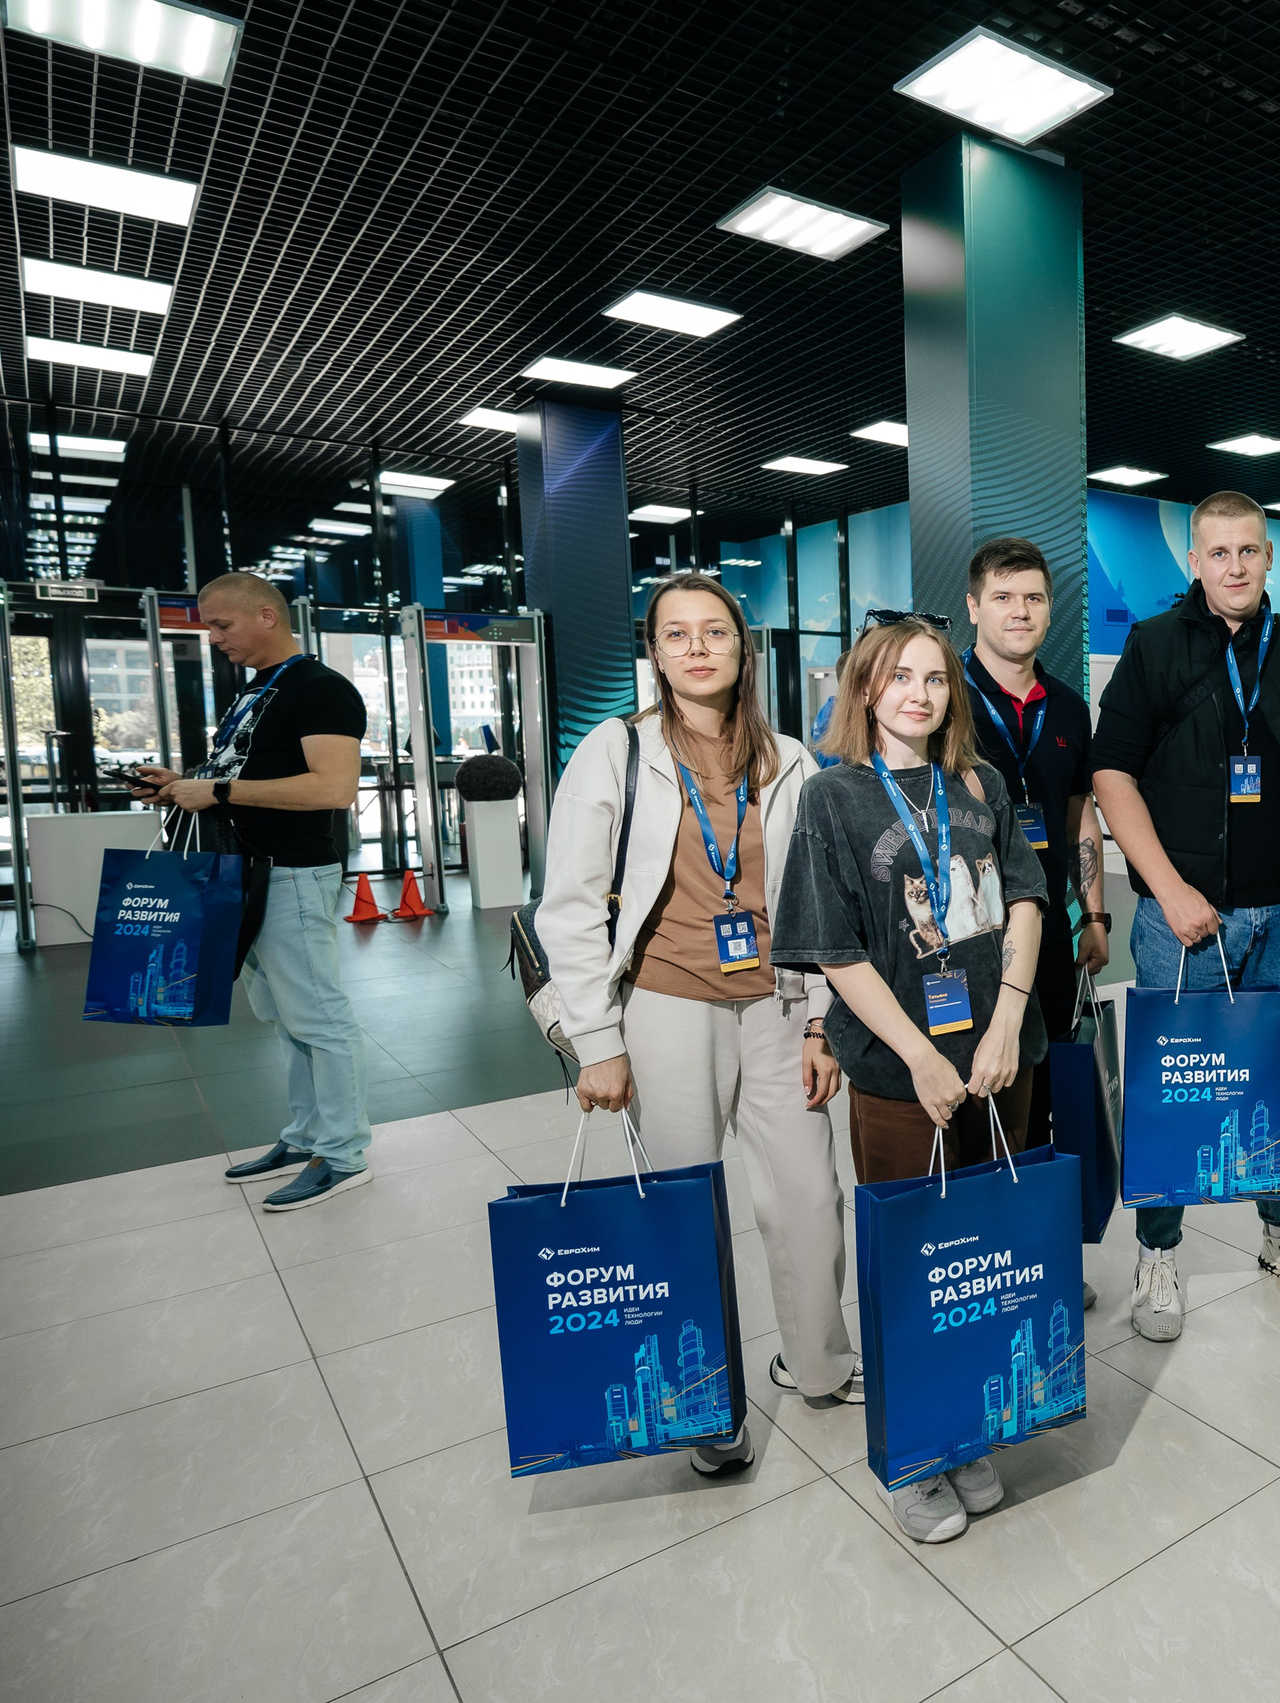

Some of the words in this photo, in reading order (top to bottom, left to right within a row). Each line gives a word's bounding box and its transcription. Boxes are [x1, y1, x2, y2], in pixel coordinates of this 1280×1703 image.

[122, 897, 169, 909] ФОРУМ
[117, 910, 180, 922] РАЗВИТИЯ
[114, 923, 150, 936] 2024
[1161, 1053, 1225, 1067] ФОРУМ
[1162, 1069, 1249, 1084] РАЗВИТИЯ
[1162, 1087, 1212, 1103] 2024
[928, 1250, 1012, 1283] ФОРУМ
[546, 1264, 634, 1288] ФОРУМ
[930, 1264, 1044, 1308] РАЗВИТИЯ
[548, 1282, 669, 1310] РАЗВИТИЯ
[1000, 1292, 1016, 1300] ИДЕИ
[1001, 1293, 1037, 1306] ТЕХНОЛОГИИ
[624, 1311, 663, 1319] ТЕХНОЛОГИИ
[932, 1297, 997, 1333] 2024
[1001, 1304, 1018, 1313] ЛЮДИ
[549, 1308, 620, 1334] 2024
